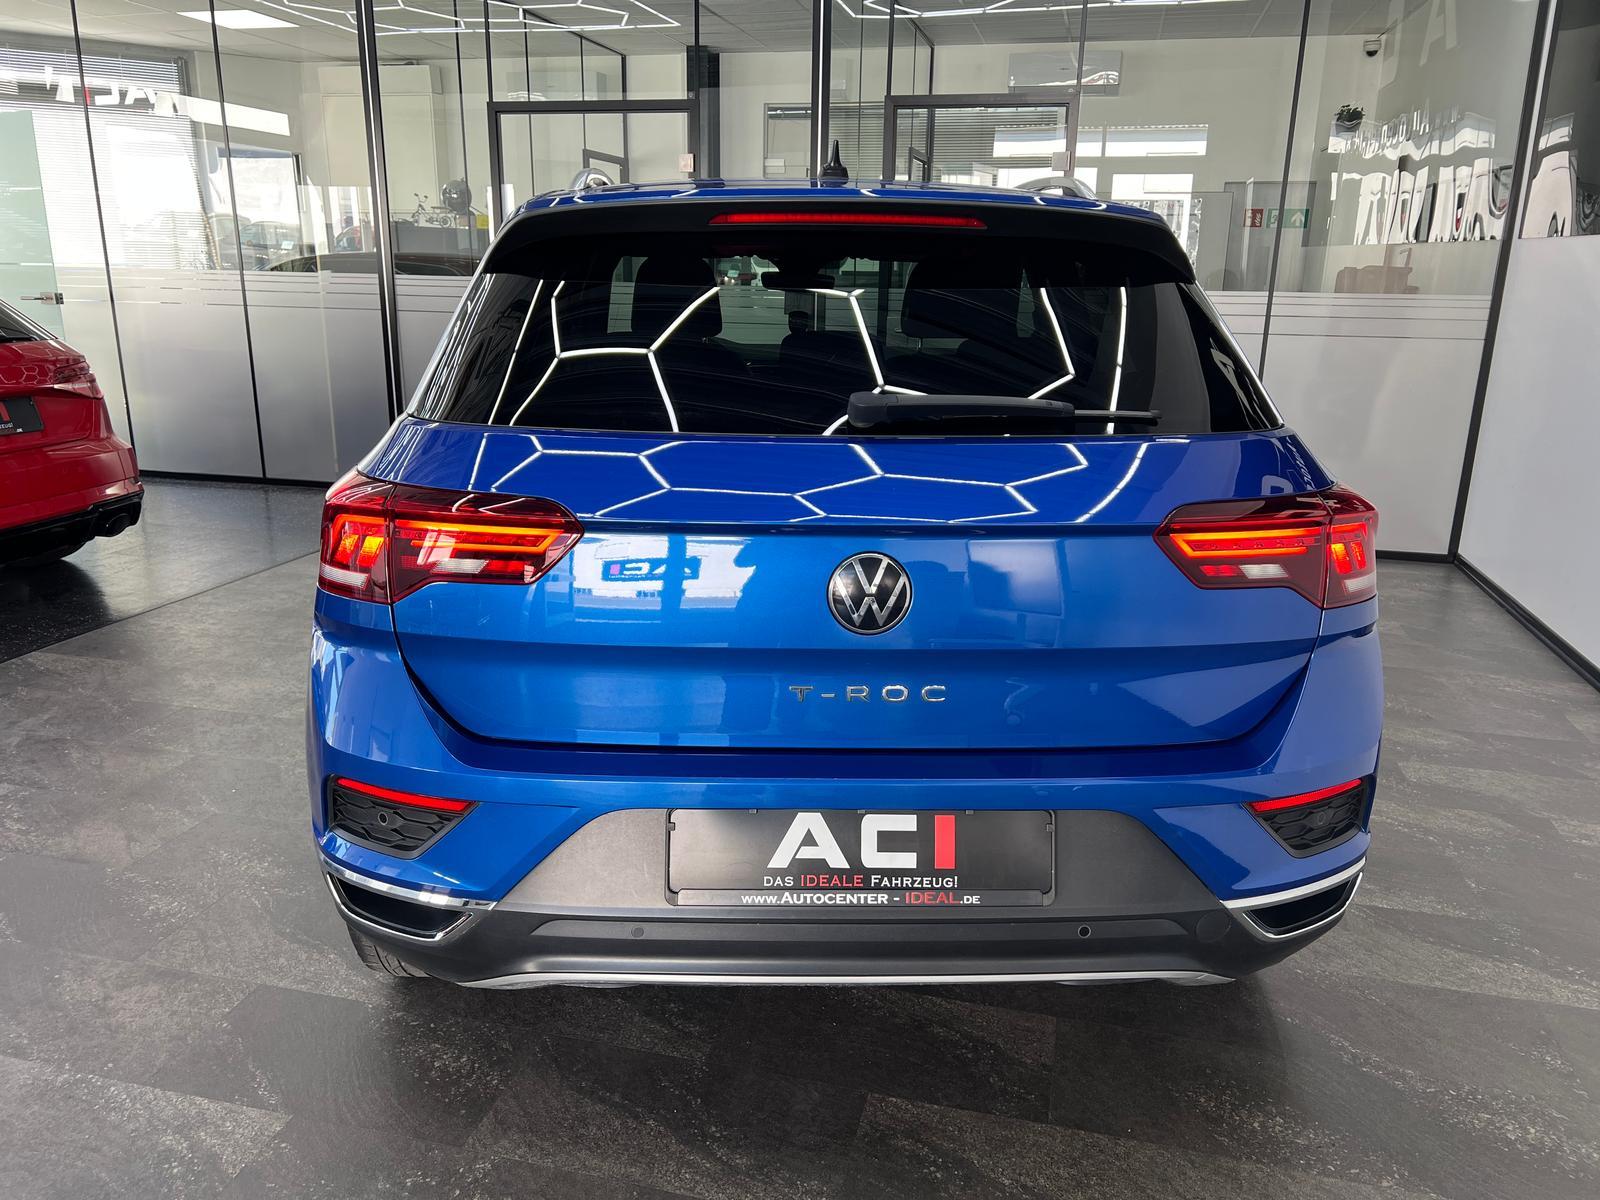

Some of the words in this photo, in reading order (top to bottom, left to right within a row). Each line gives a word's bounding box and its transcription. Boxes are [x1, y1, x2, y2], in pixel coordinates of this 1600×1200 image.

[788, 684, 947, 703] T-ROC
[766, 812, 956, 869] ACI
[763, 876, 794, 887] DAS
[800, 874, 864, 887] IDEALE
[870, 874, 958, 888] FAHRZEUG!
